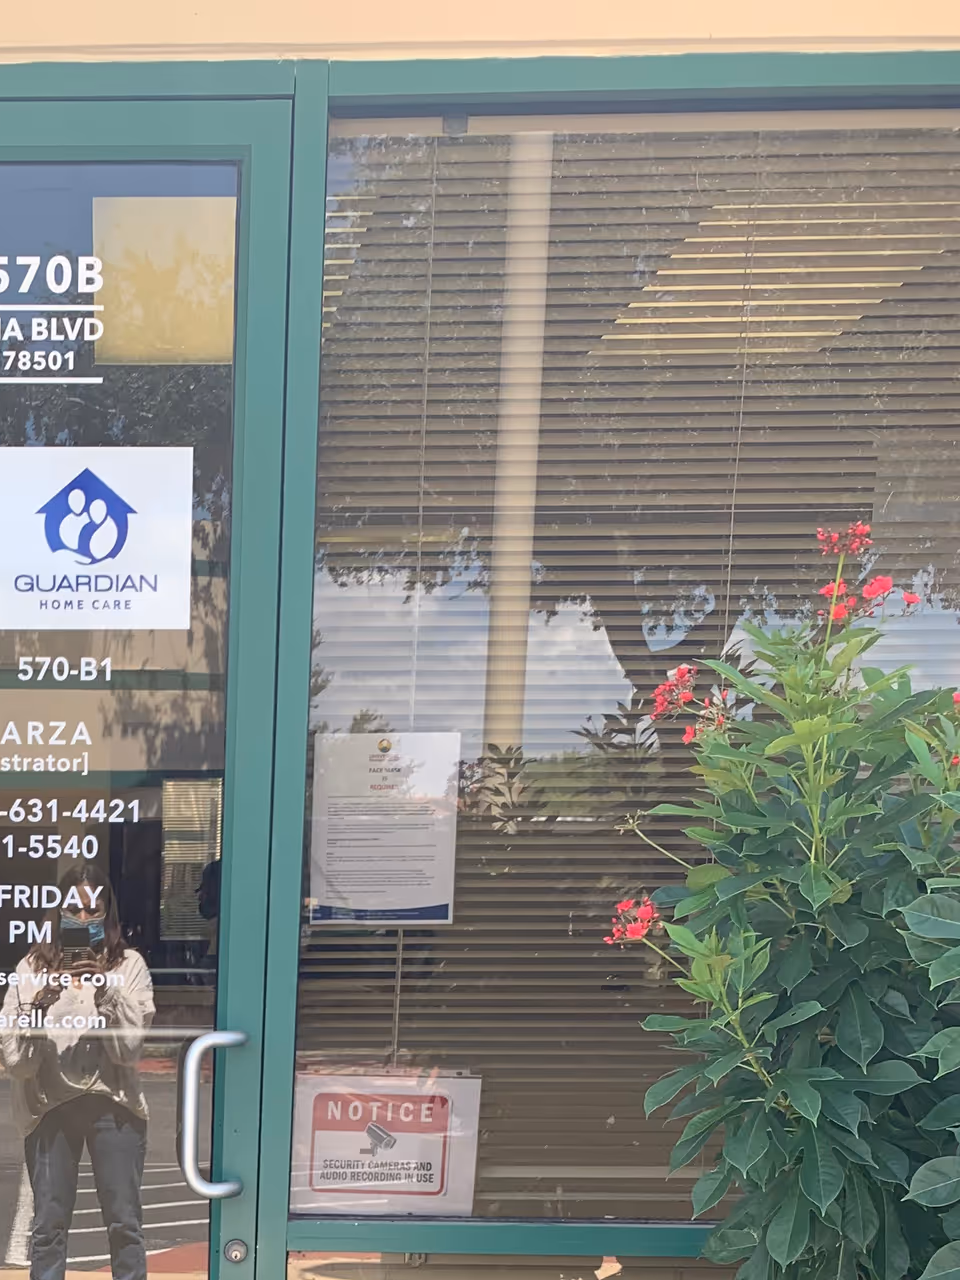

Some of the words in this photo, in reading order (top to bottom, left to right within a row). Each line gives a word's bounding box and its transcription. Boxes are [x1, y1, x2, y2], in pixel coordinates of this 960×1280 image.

[30, 318, 105, 342] BLVD
[2, 351, 76, 371] 78501
[14, 574, 158, 594] GUARDIAN
[39, 600, 87, 610] HOME
[91, 600, 132, 610] CARE
[17, 656, 112, 682] 570-B1
[8, 921, 53, 944] PM
[327, 1101, 433, 1122] NOTICE
[323, 1159, 365, 1170] SECURITY
[368, 1160, 411, 1171] CAMERAS
[413, 1161, 432, 1171] AND
[320, 1171, 347, 1181] AUDIO
[350, 1171, 402, 1182] RECORDING
[404, 1172, 414, 1182] IN
[416, 1173, 434, 1183] USE
